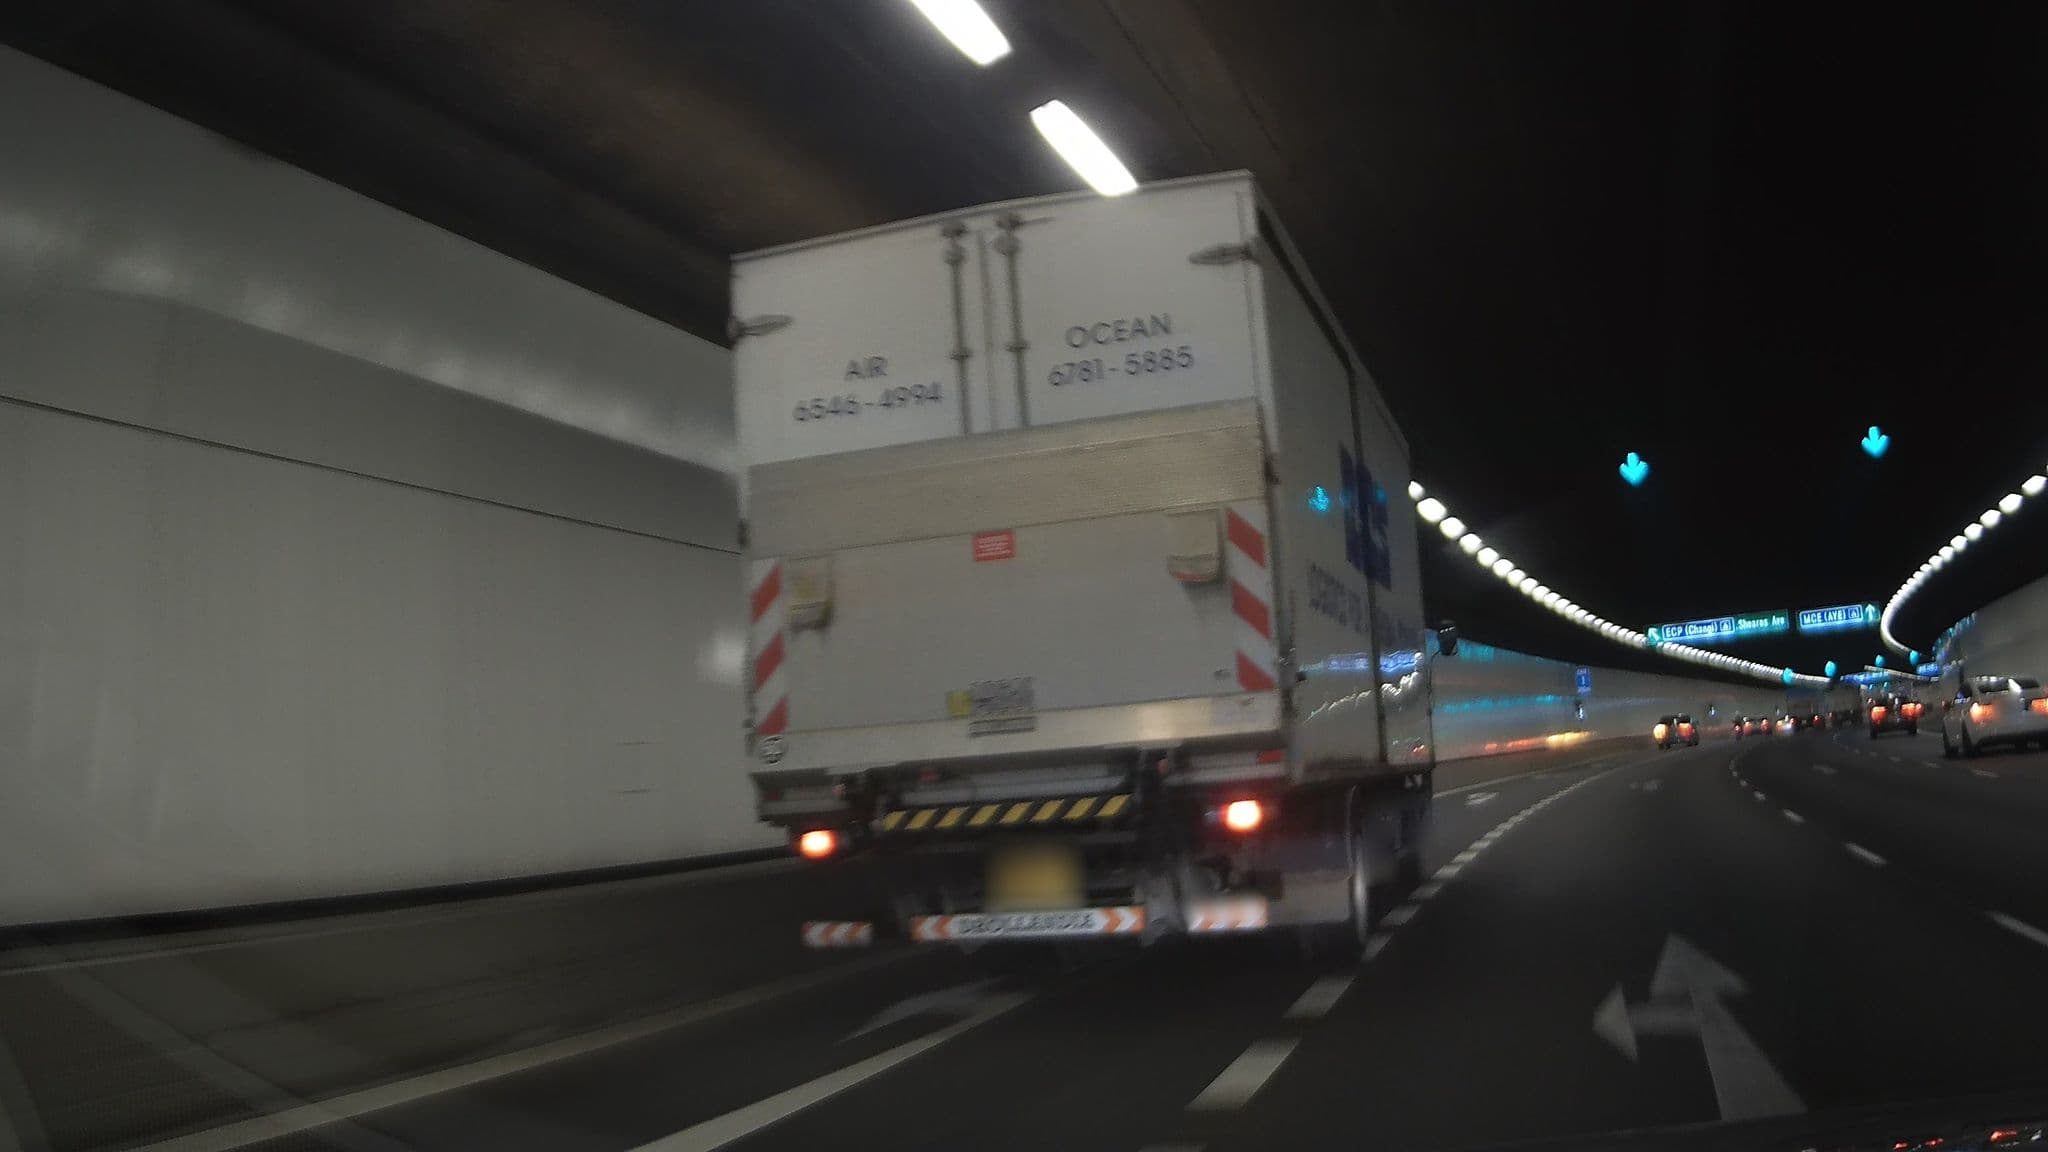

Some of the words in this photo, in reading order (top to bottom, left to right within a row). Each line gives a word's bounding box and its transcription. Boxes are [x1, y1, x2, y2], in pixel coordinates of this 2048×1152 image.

[1064, 313, 1172, 348] OCEAN
[844, 356, 889, 381] AIR
[1665, 626, 1683, 638] ECP
[1685, 621, 1718, 636] (Changi)
[1737, 618, 1769, 630] Sheares
[1771, 615, 1785, 626] Ave
[1803, 612, 1822, 624] MCE
[1824, 608, 1847, 622] (AYE)
